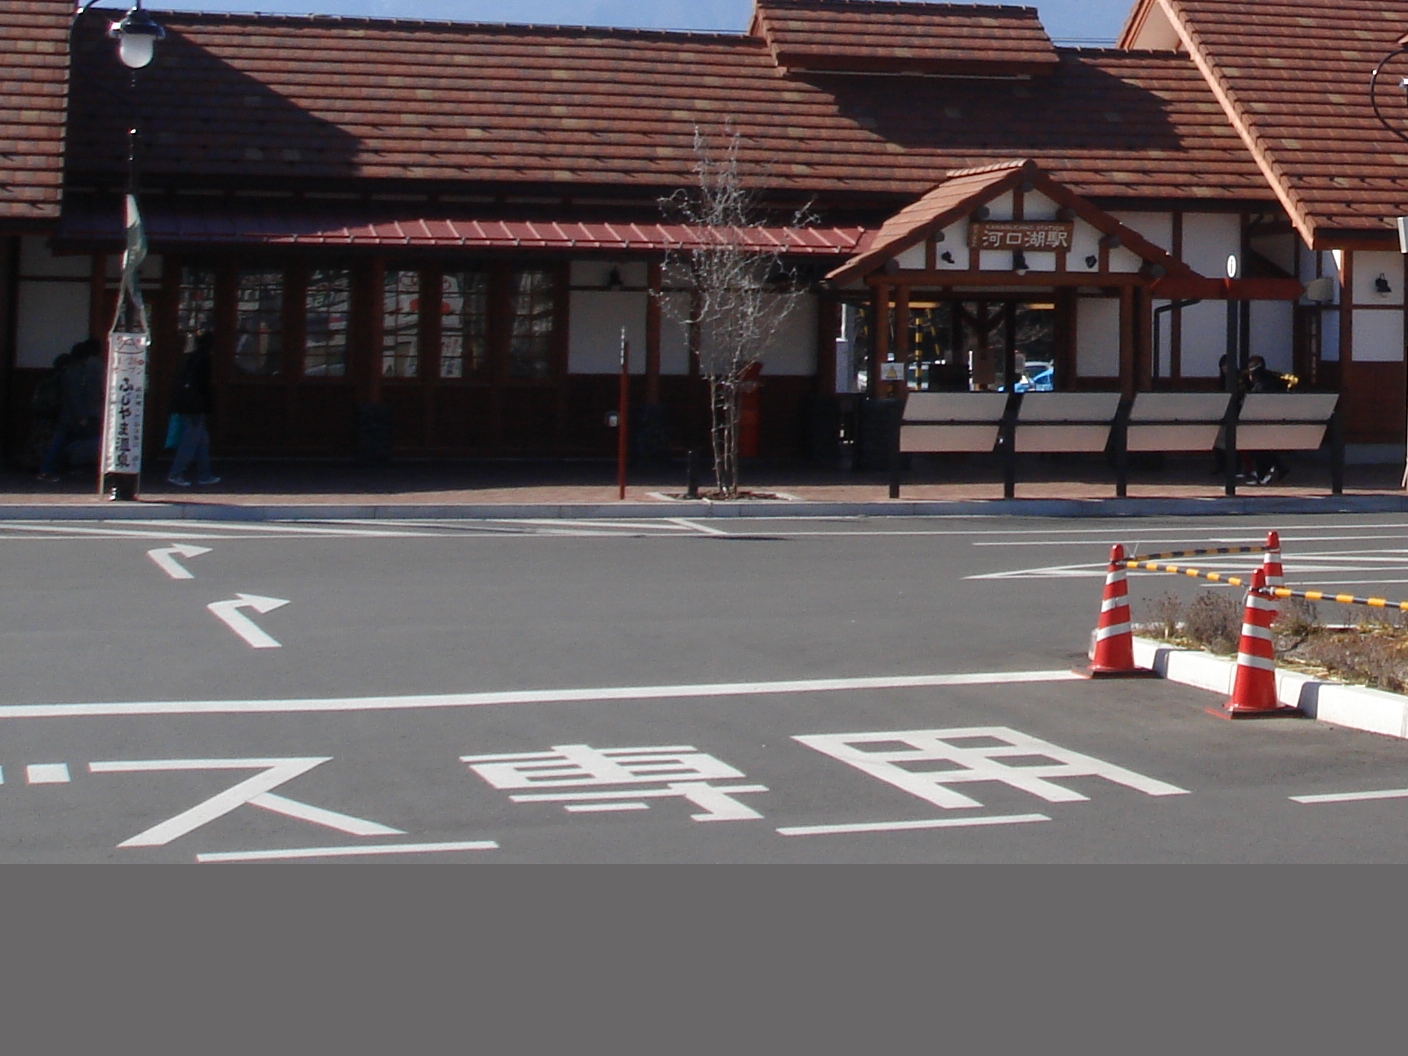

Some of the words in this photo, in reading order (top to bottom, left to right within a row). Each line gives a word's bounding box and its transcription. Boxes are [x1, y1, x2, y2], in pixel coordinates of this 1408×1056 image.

[982, 230, 1068, 248] 河口湖駅
[0, 727, 1191, 848] ス専用
